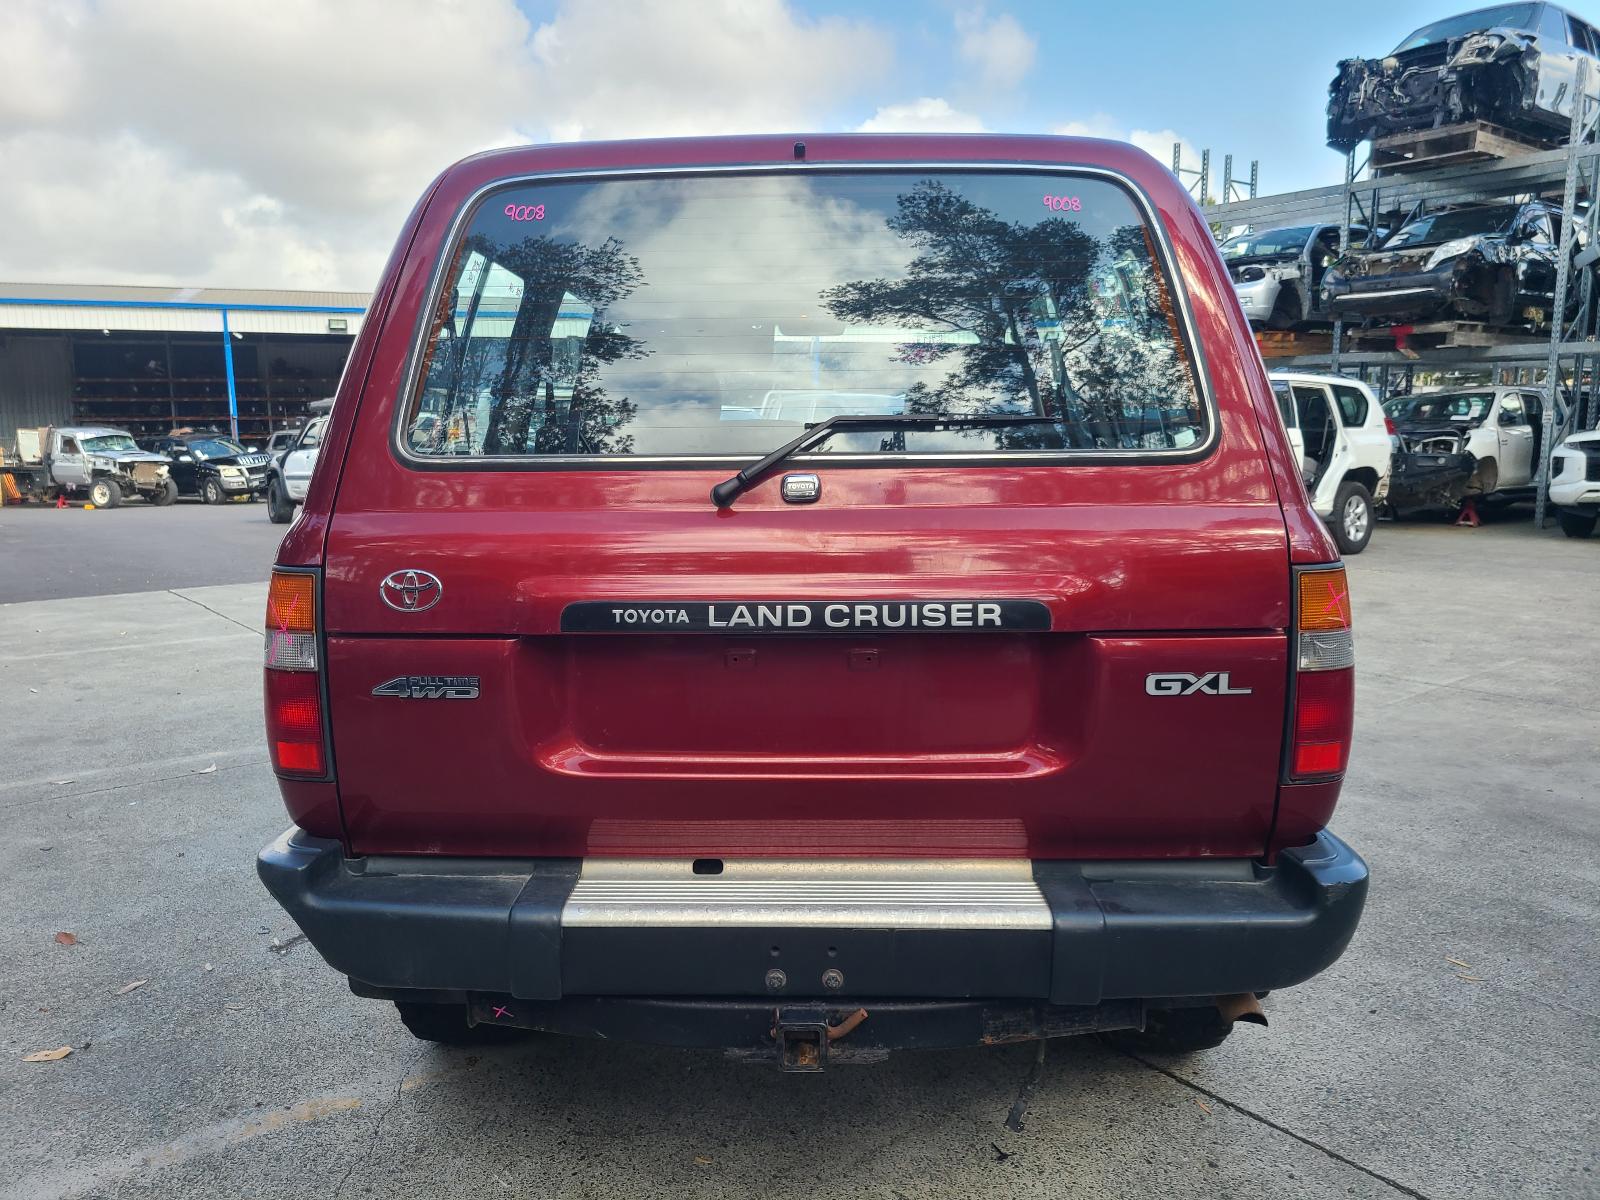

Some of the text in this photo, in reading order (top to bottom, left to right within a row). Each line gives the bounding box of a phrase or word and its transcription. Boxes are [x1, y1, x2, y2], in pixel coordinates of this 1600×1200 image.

[504, 203, 546, 221] 9008
[1043, 195, 1081, 211] 9008
[611, 603, 1002, 628] TOYOTA LAND CRUISER
[371, 677, 480, 699] 4WD
[409, 676, 479, 686] FULL TIME
[1144, 671, 1252, 696] GXL
